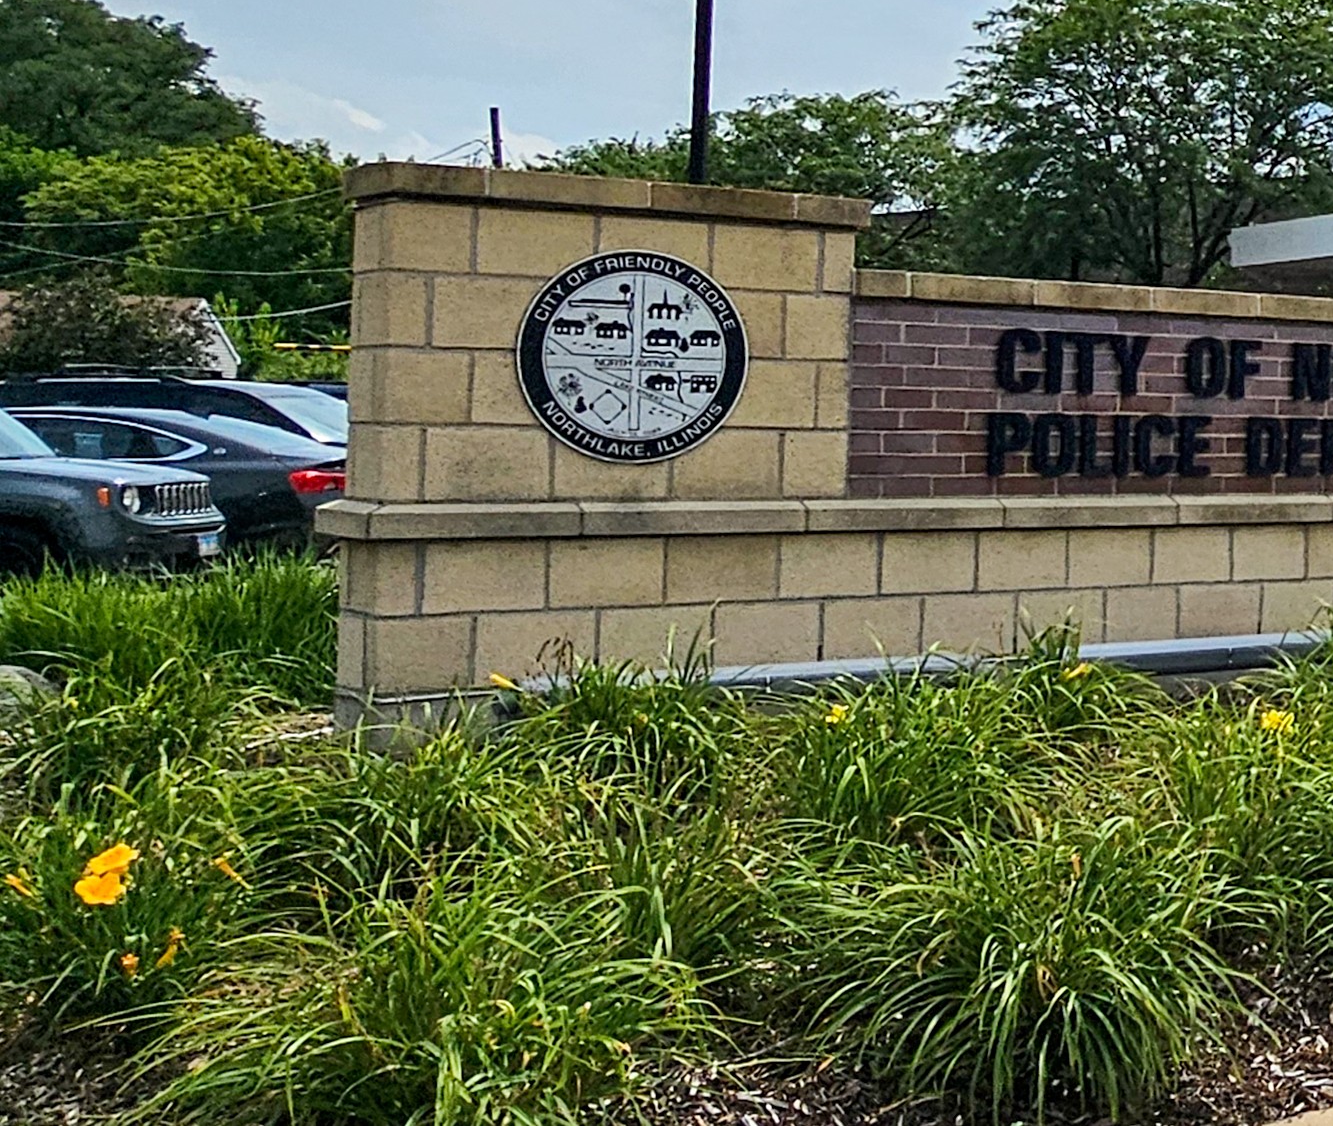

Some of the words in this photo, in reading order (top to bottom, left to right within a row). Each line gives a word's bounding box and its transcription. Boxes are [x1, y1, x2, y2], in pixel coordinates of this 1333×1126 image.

[534, 286, 566, 321] CITY
[568, 269, 592, 287] OF
[594, 256, 685, 276] FRIENDLY
[688, 275, 737, 330] PEOPLE
[998, 328, 1152, 395] CITY
[1186, 337, 1262, 399] OF
[542, 401, 651, 457] NORTHLAKE,
[657, 404, 723, 453] ILLINOIS
[986, 412, 1212, 476] POLICE
